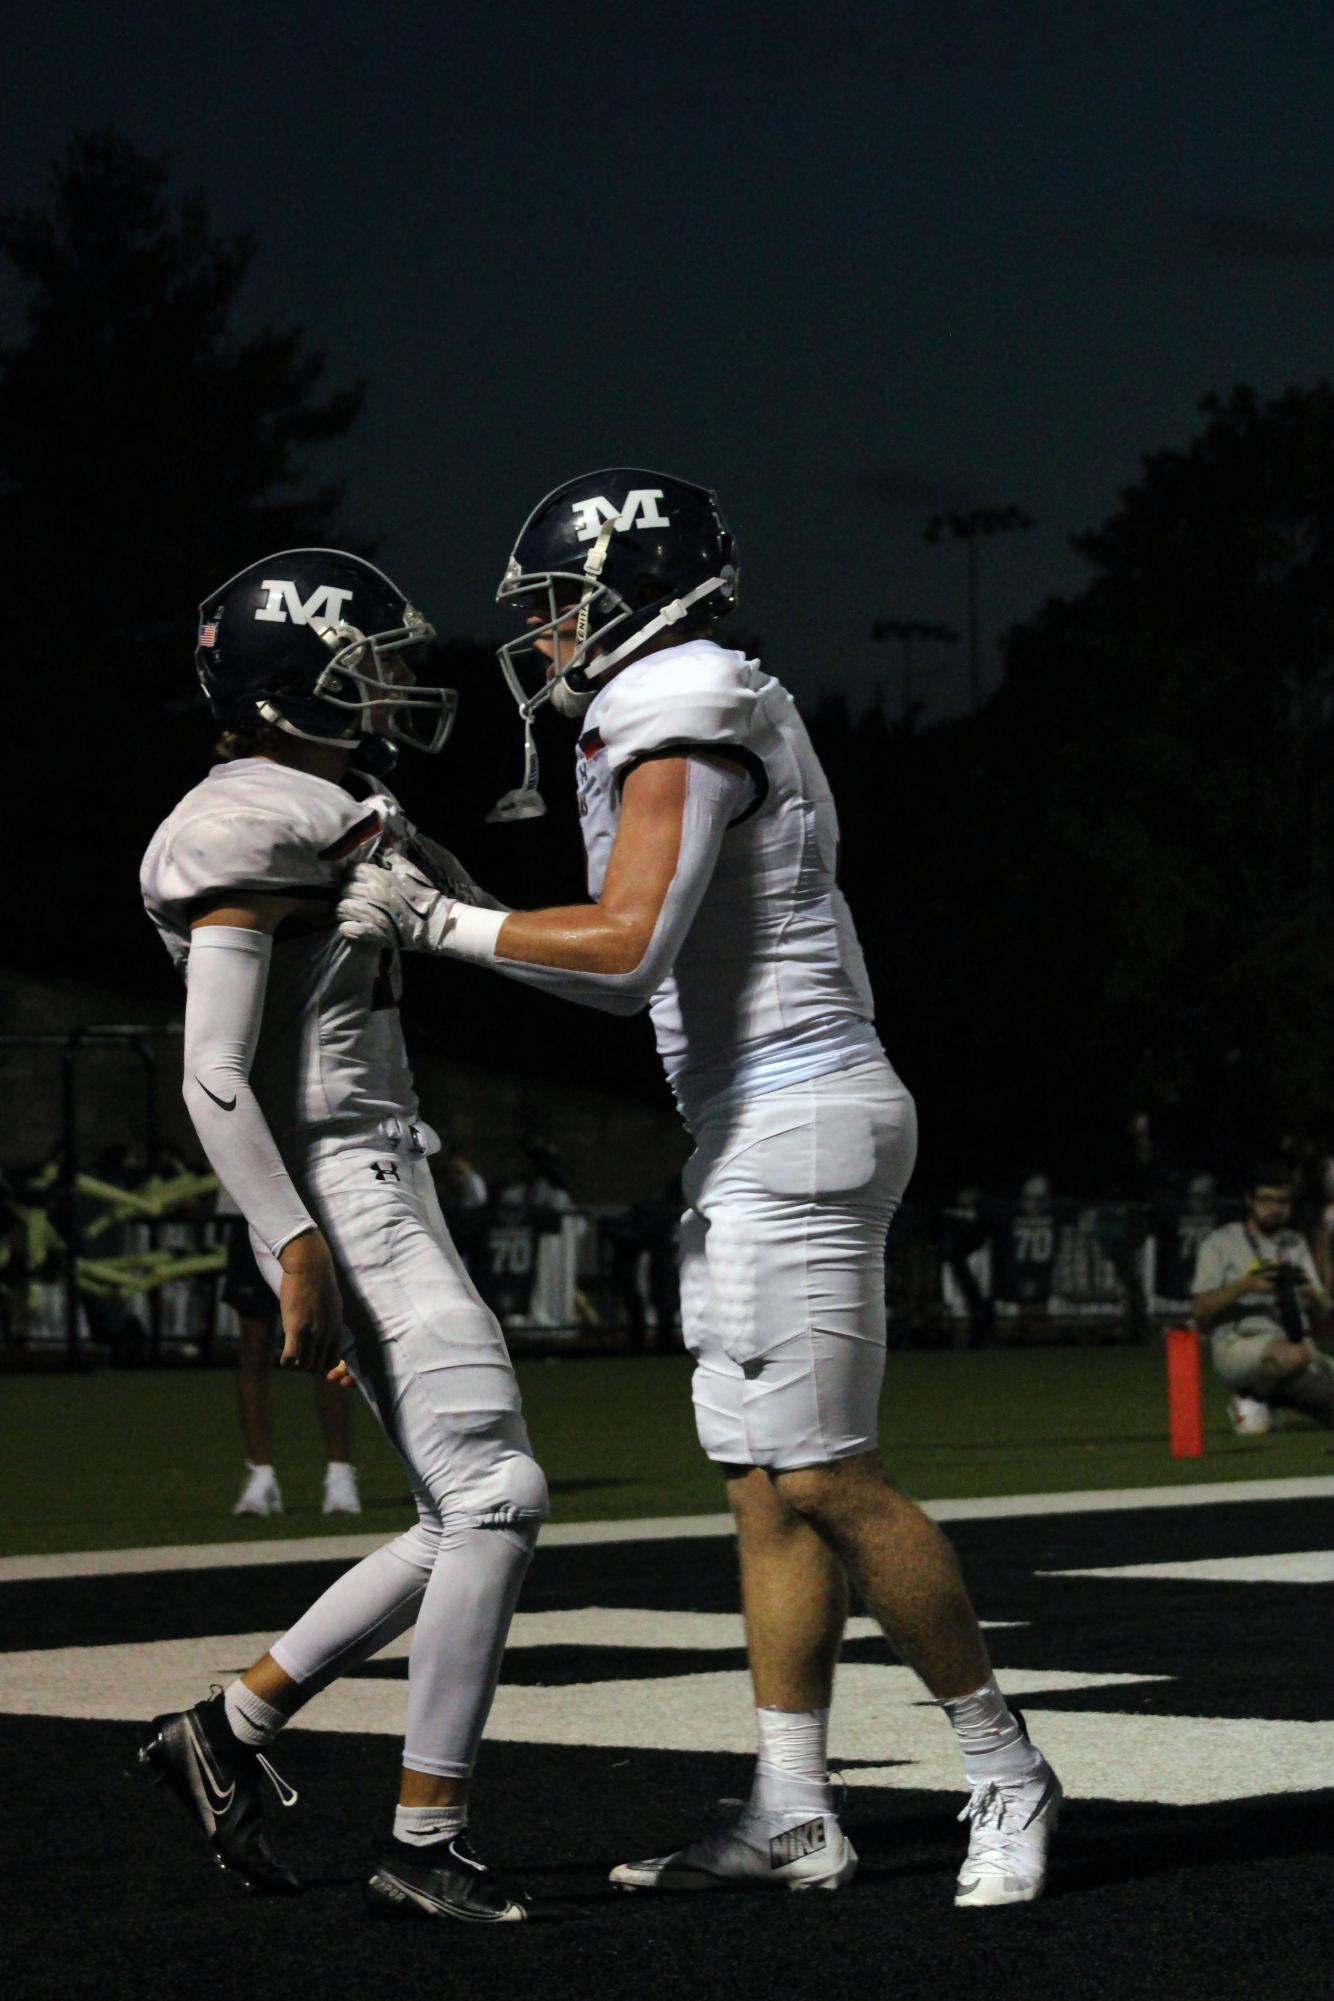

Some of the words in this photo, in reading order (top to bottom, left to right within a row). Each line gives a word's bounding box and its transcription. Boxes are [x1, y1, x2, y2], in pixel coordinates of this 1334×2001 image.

[570, 489, 671, 542] M
[254, 579, 354, 626] M
[576, 605, 587, 646] XENIT
[770, 1818, 826, 1868] NIKE
